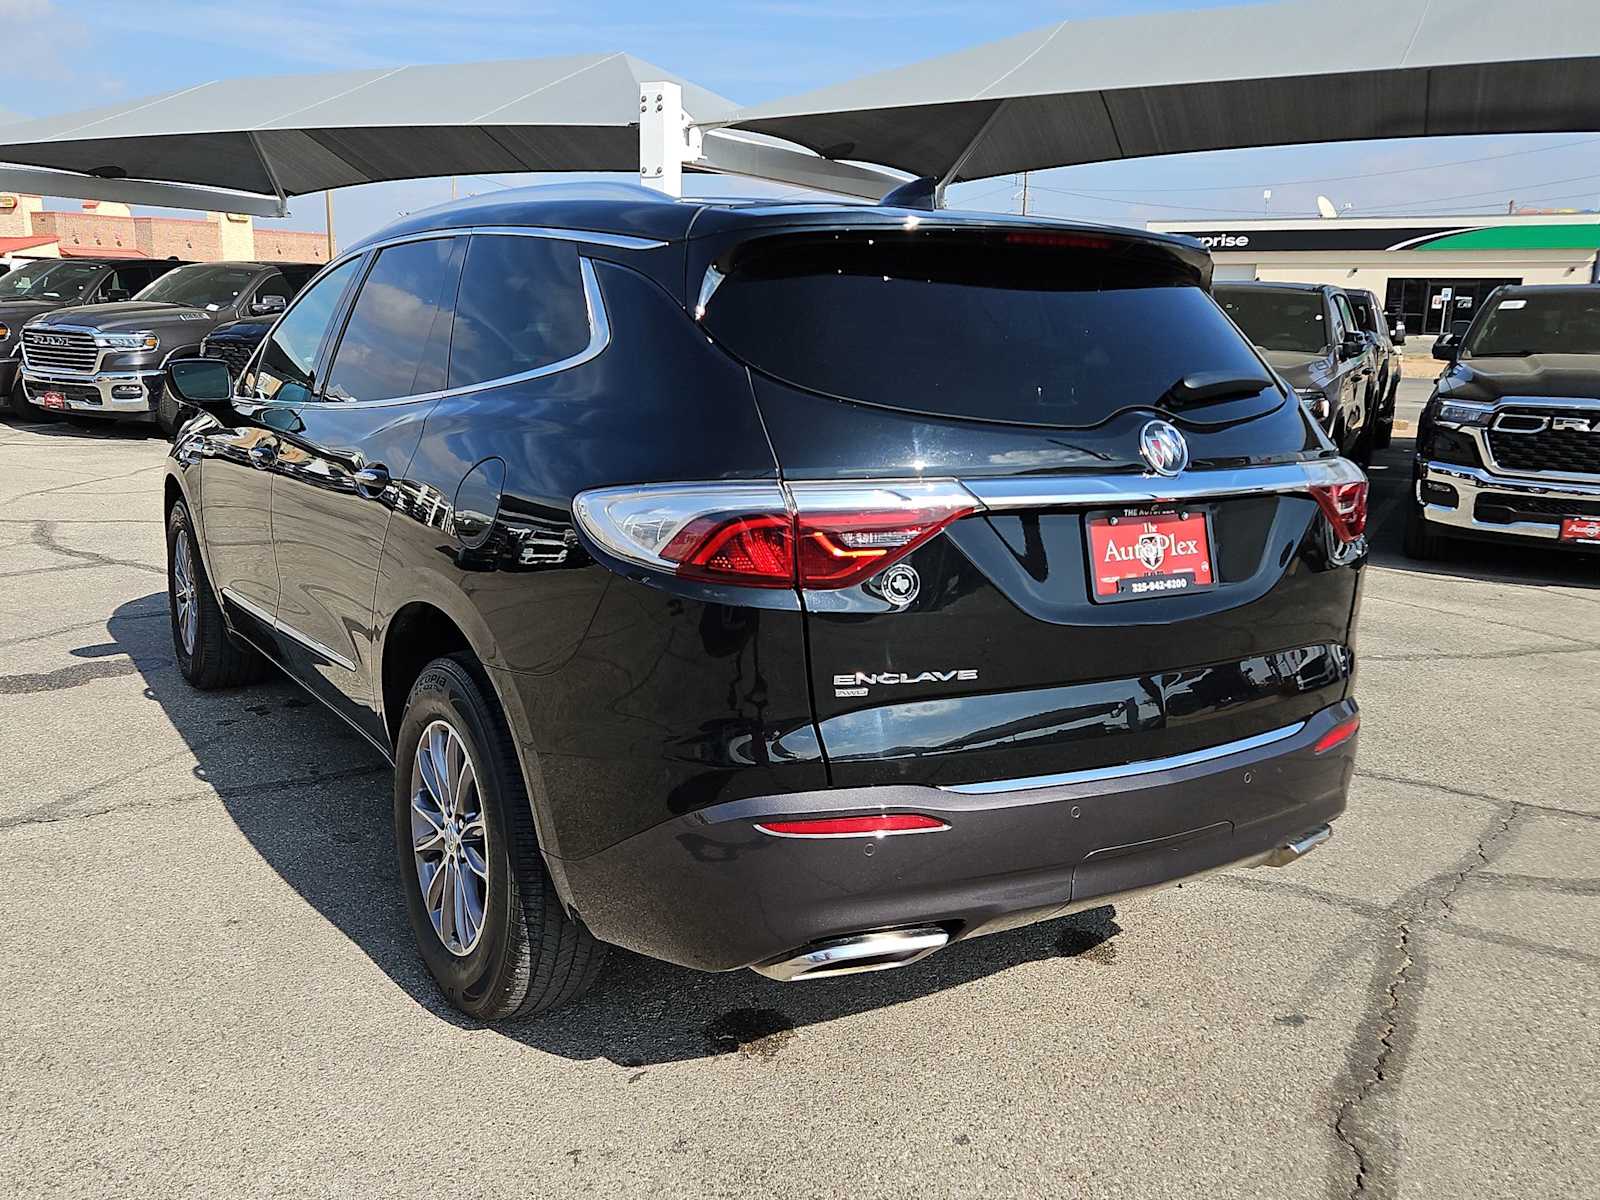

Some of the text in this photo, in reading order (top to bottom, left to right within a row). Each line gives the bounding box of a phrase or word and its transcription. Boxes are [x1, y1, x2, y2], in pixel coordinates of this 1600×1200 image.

[1124, 508, 1138, 517] THE
[1143, 522, 1159, 533] The
[1104, 532, 1200, 563] AutoPlex
[833, 669, 979, 686] ENCLAVE
[836, 688, 868, 697] AWD
